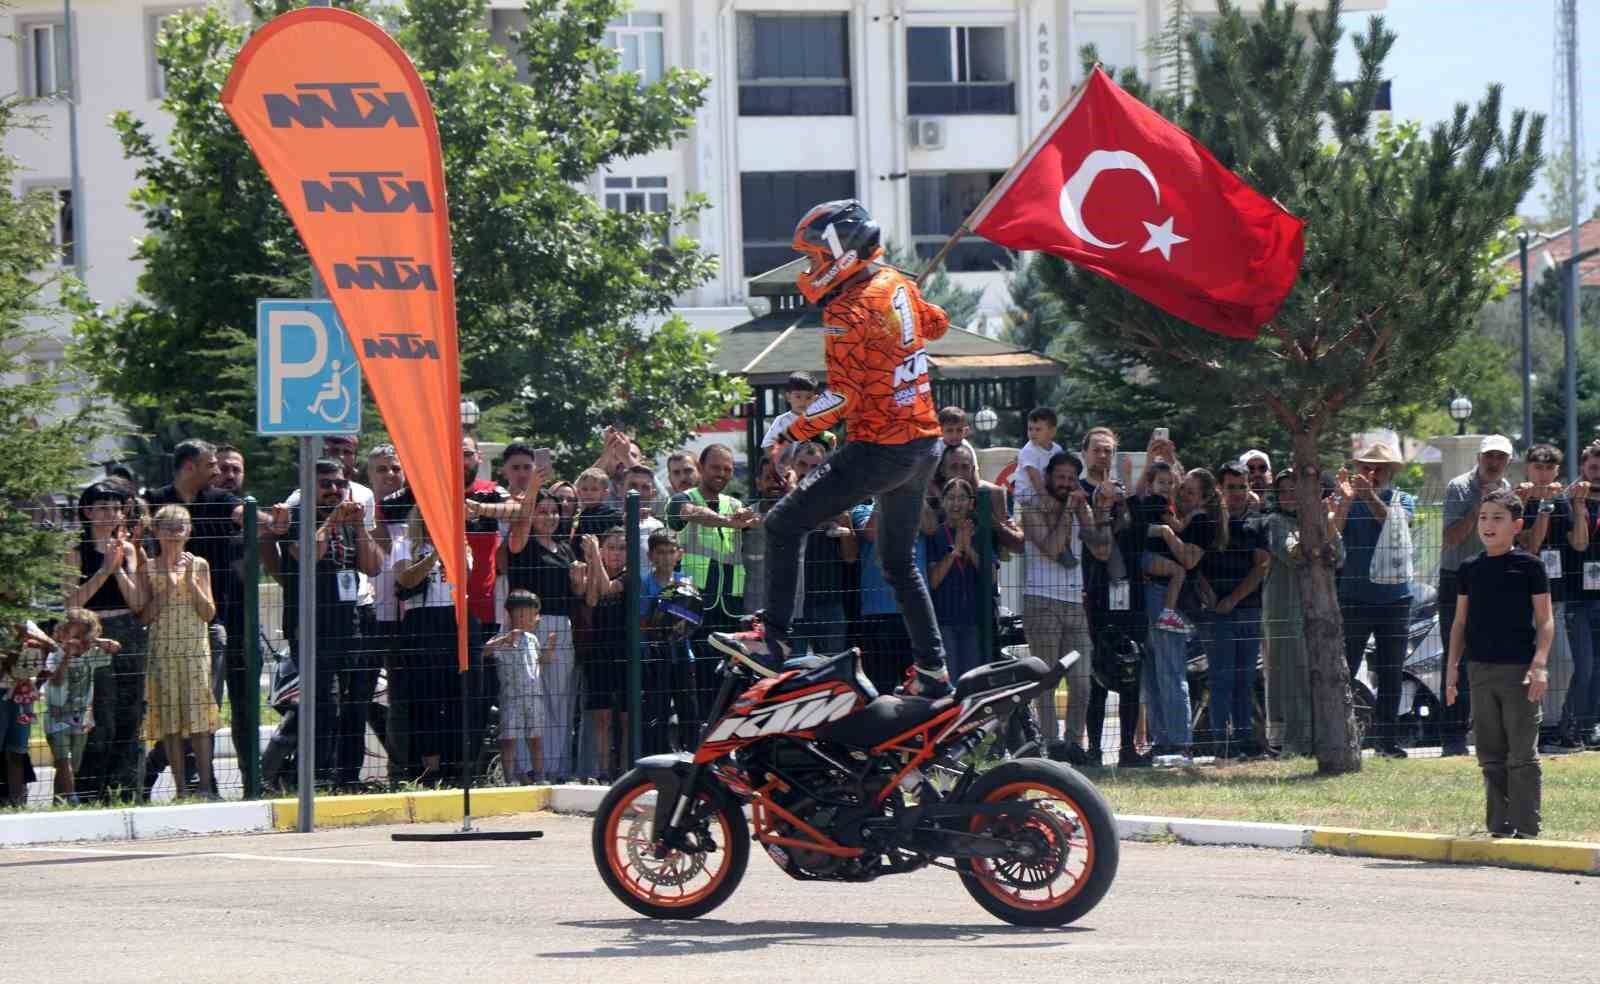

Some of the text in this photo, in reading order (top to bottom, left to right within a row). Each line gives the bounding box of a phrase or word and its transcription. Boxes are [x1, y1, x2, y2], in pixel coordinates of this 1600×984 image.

[1037, 22, 1050, 112] AKDAĞ
[821, 222, 845, 260] 1
[891, 285, 915, 347] 1
[268, 310, 328, 424] P
[705, 689, 858, 744] KTM
